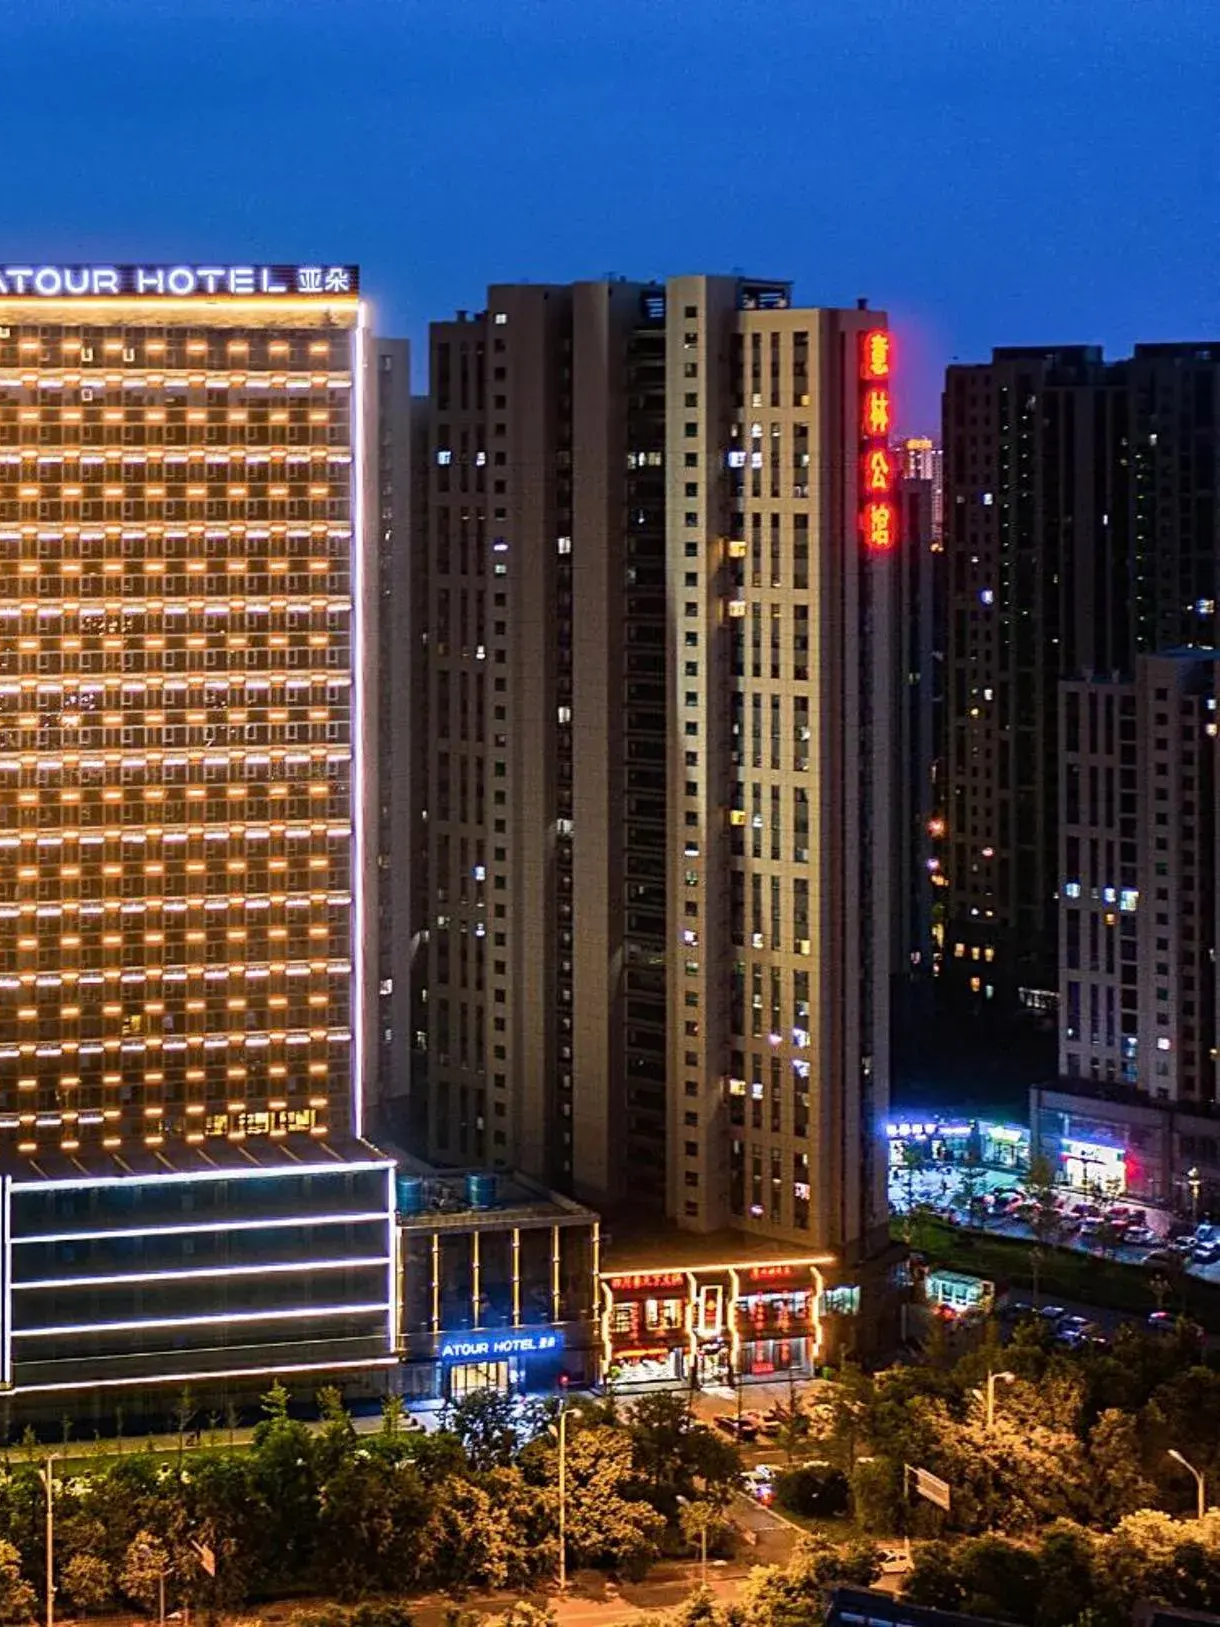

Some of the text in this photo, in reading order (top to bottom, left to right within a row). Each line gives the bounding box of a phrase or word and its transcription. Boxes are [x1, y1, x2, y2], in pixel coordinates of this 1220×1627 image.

[138, 268, 287, 294] HOTEL
[298, 267, 350, 293] 亚朵
[442, 1342, 489, 1357] ATOUR
[493, 1338, 537, 1353] HOTEL
